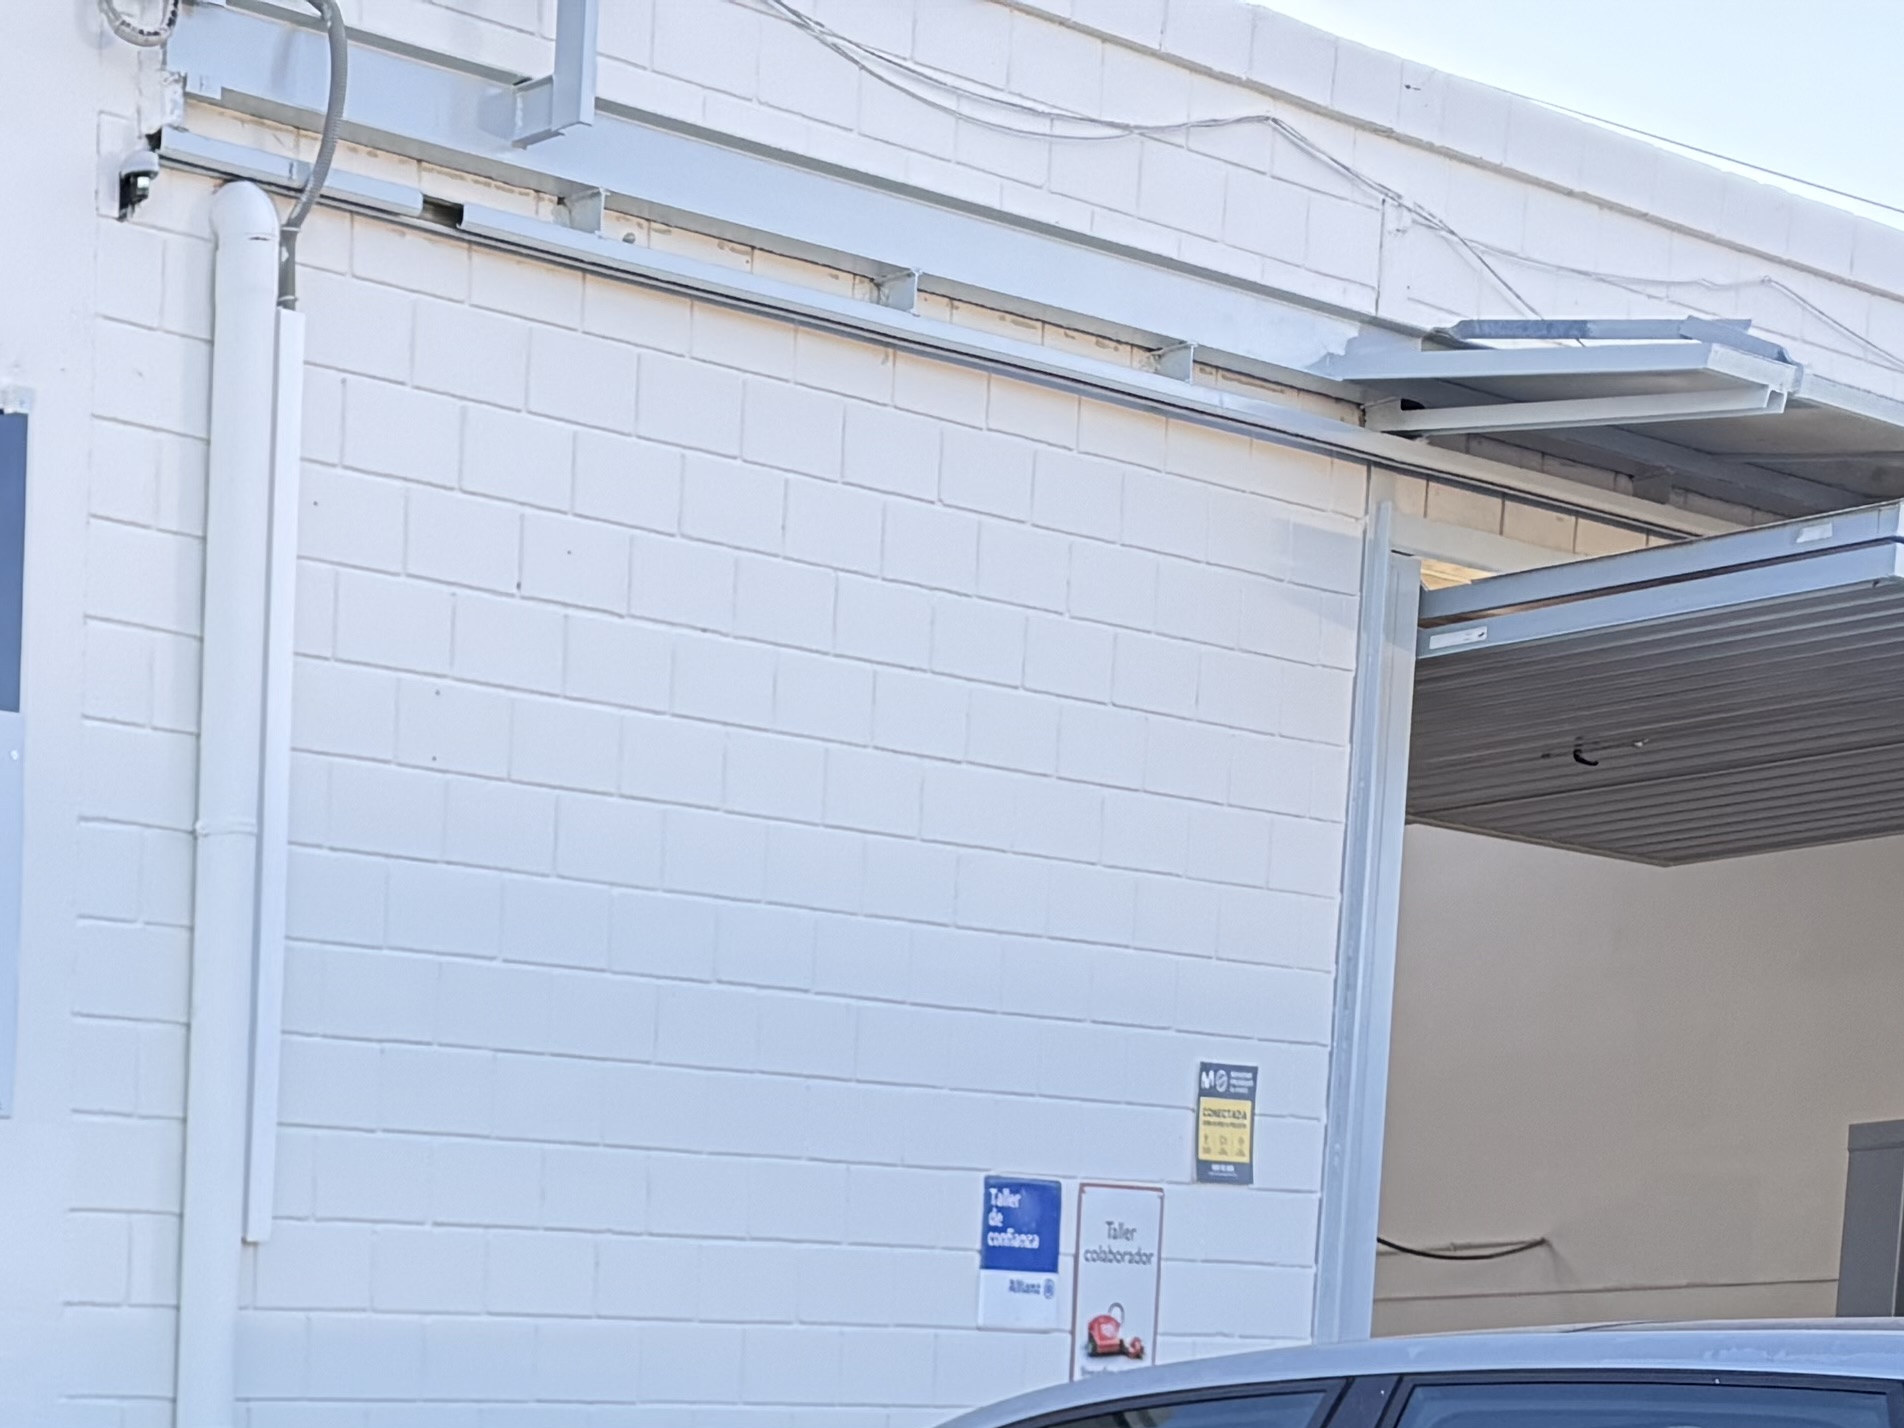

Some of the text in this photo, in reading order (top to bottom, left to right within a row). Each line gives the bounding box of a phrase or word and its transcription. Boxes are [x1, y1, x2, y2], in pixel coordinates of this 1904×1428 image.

[989, 1188, 1021, 1208] Taller
[988, 1208, 1004, 1227] de
[1106, 1221, 1137, 1241] Taller
[1084, 1245, 1155, 1265] colaborador
[1008, 1279, 1041, 1295] Allianz
